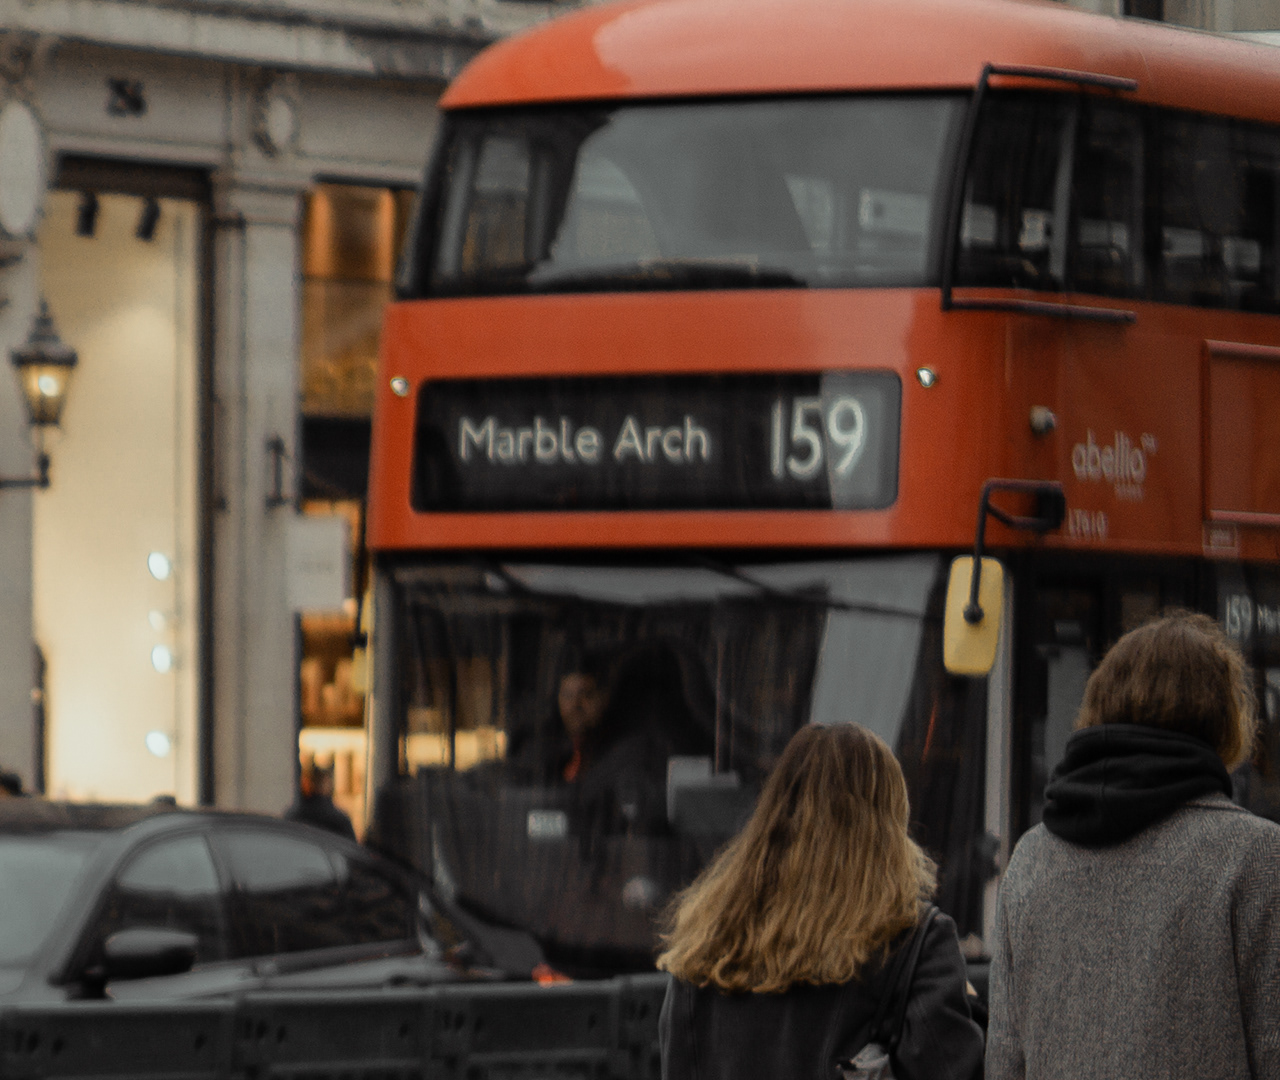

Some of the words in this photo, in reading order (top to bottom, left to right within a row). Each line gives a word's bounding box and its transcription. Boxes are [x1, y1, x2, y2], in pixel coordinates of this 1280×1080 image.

[458, 415, 603, 463] Marble
[613, 414, 712, 464] Arch
[770, 395, 868, 480] 159
